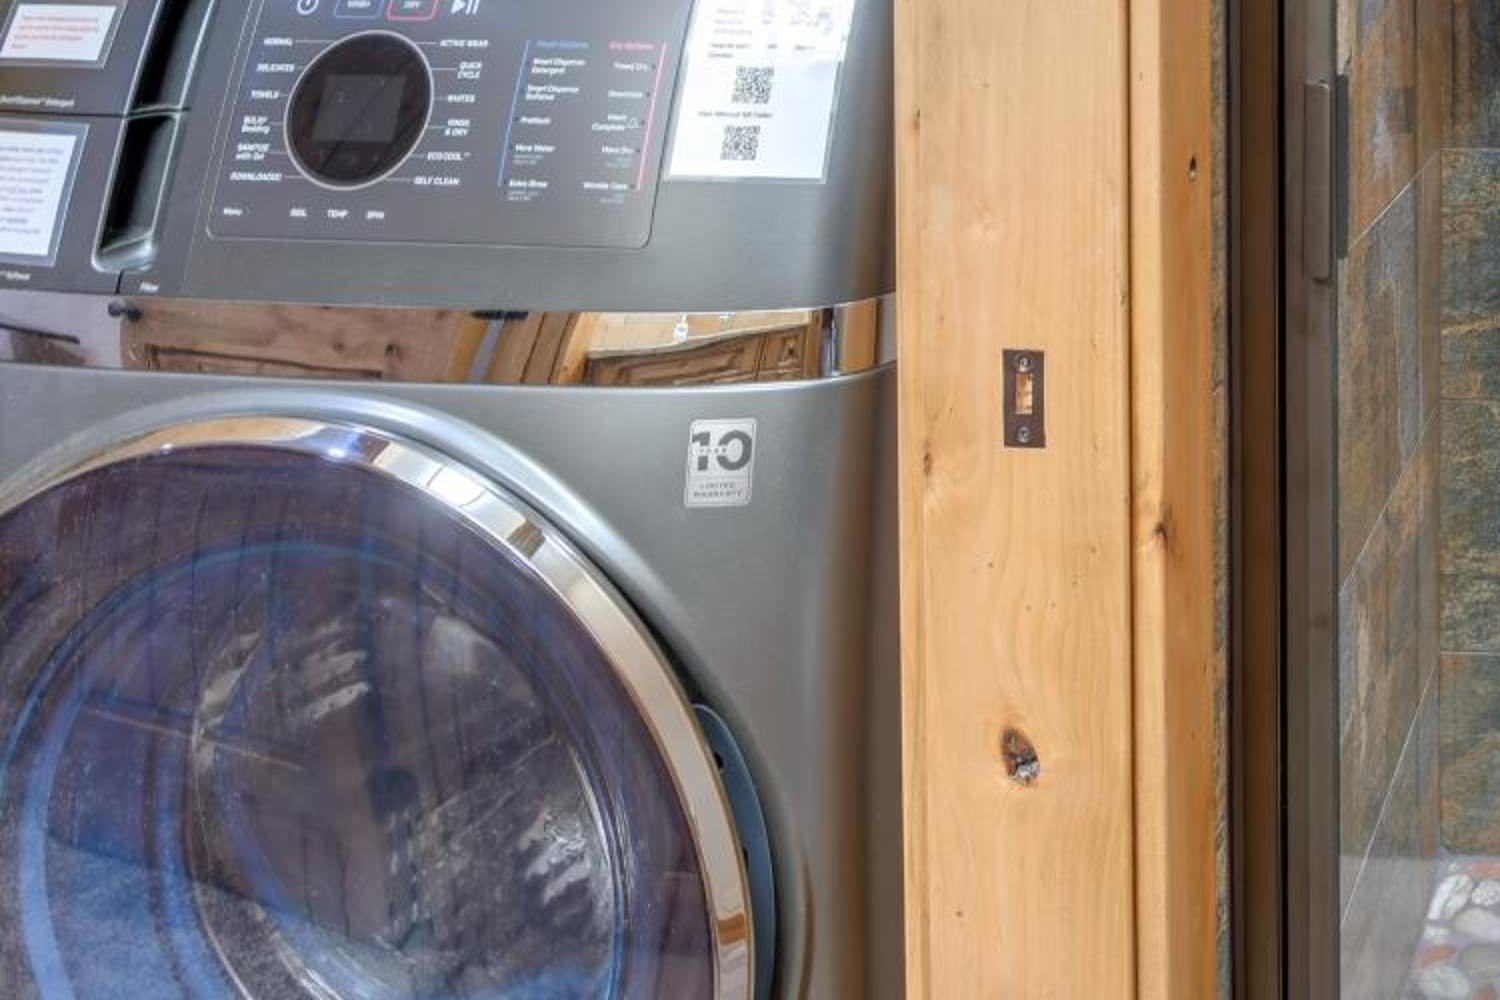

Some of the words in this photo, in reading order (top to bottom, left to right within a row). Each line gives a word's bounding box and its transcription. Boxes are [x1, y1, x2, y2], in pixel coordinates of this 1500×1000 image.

[403, 0, 421, 9] DRY
[263, 37, 293, 47] NORMAL
[256, 63, 295, 73] DELICATES
[457, 70, 480, 79] CYCLE
[251, 90, 280, 99] TOWELS
[447, 94, 475, 103] WHITES
[229, 171, 282, 181] DOWNLOADED
[434, 177, 460, 185] CLEAN
[327, 208, 349, 218] TEMP
[691, 429, 753, 471] 10
